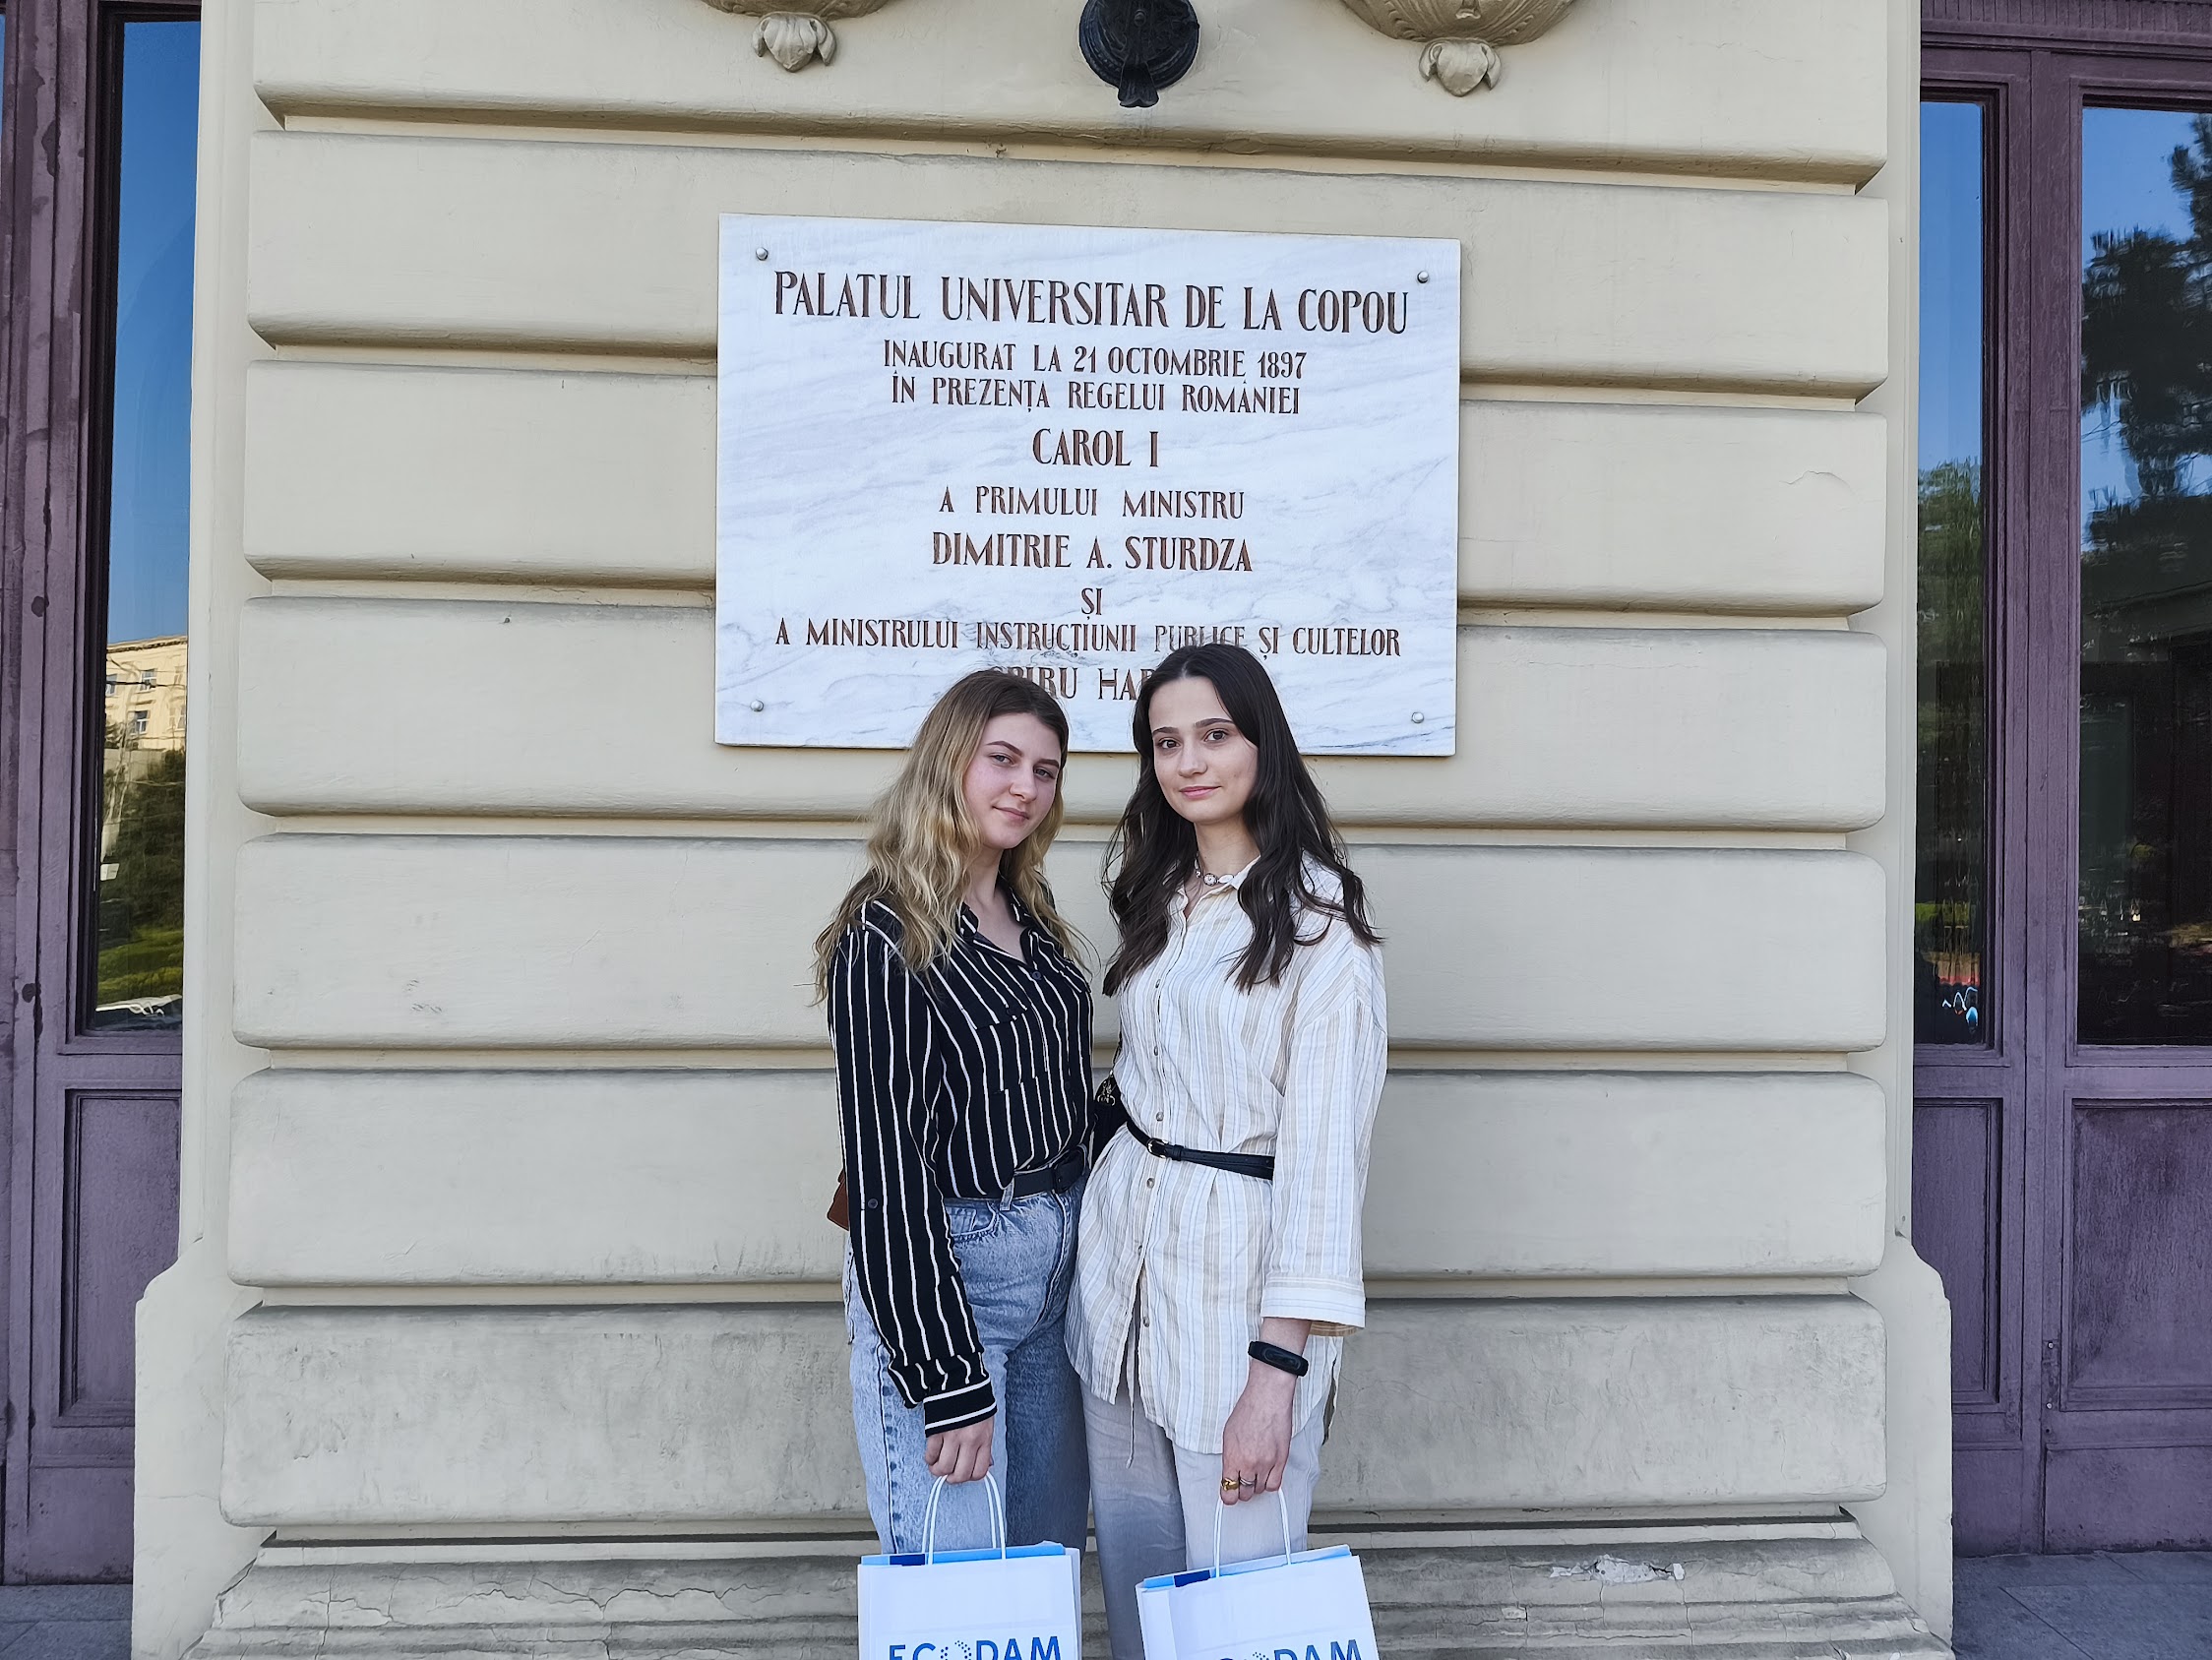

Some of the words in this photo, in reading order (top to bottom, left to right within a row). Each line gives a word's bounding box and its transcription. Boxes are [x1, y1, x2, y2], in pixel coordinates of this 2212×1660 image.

[774, 270, 921, 319] PALATUL
[941, 276, 1169, 328] UNIVERSITAR
[1185, 284, 1226, 329] DE
[1243, 286, 1283, 331] LA
[1297, 288, 1410, 335] COPOU
[884, 338, 1016, 371] INAUGURAT
[1032, 343, 1063, 373] LA
[1073, 345, 1098, 374] 21
[1107, 346, 1247, 378] OCTOMBRIE
[1257, 351, 1307, 379] 1897
[891, 370, 916, 403] ÎN
[932, 377, 1051, 413] PREZENȚA
[1068, 381, 1166, 411] REGELUI
[1181, 378, 1302, 415] ROMÂNIEI
[1031, 427, 1133, 468] CAROL
[1148, 429, 1160, 468] I
[939, 486, 955, 515] A
[975, 486, 1098, 518] PRIMULUI
[1122, 489, 1246, 521] MINISTRU
[931, 530, 1073, 569] DIMITRIE
[1085, 535, 1115, 570] A.
[1124, 535, 1254, 573] STURDZA
[1080, 586, 1103, 620] ȘI
[774, 616, 790, 646] A
[805, 618, 959, 648] MINISTRULUI
[975, 621, 1137, 657] INSTRUCȚIUNII
[1259, 626, 1279, 660] ȘI
[1292, 627, 1401, 657] CULTELOR
